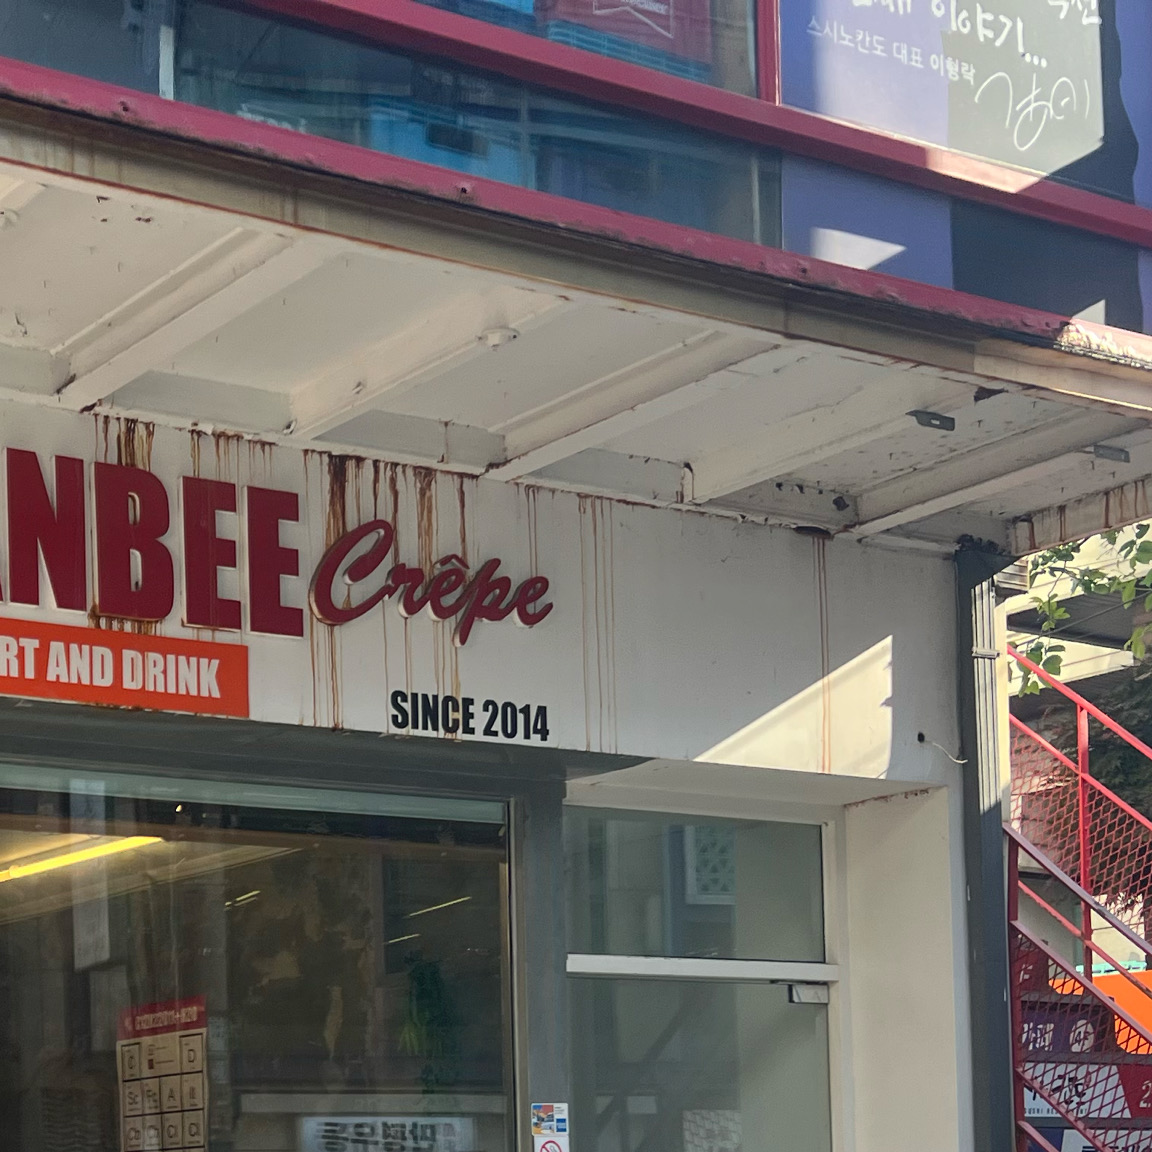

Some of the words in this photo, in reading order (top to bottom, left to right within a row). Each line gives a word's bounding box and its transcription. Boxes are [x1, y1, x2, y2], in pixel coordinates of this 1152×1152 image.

[807, 16, 889, 58] 스시노칸도
[893, 42, 924, 69] 대표
[308, 518, 554, 648] Crêpe
[46, 641, 115, 689] AND
[122, 650, 221, 700] DRINK
[389, 689, 476, 736] SINCE
[483, 698, 550, 742] 2014
